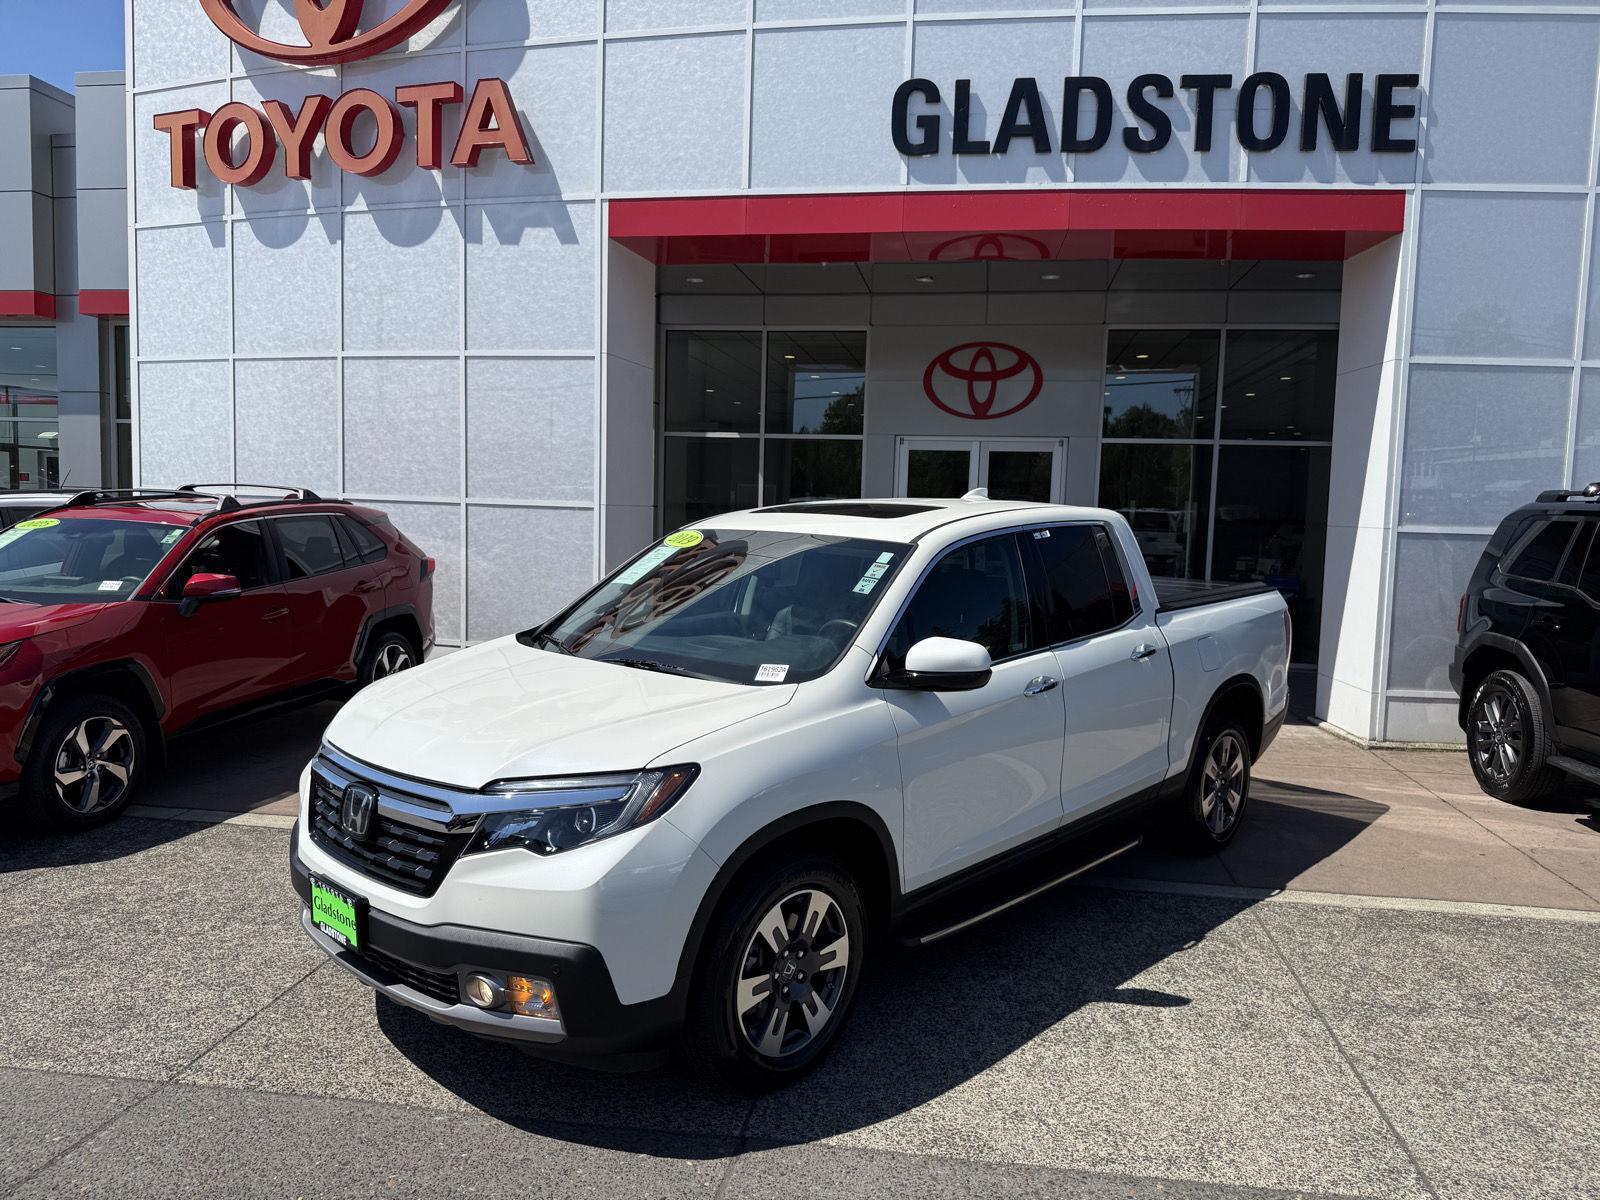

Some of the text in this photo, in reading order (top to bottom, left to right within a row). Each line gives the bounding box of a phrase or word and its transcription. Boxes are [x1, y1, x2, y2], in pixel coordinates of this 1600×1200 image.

[153, 77, 535, 189] TOYOTA
[891, 71, 1419, 156] GLADSTONE
[313, 895, 357, 931] Gladstone
[319, 921, 347, 945] GLADSTONE
